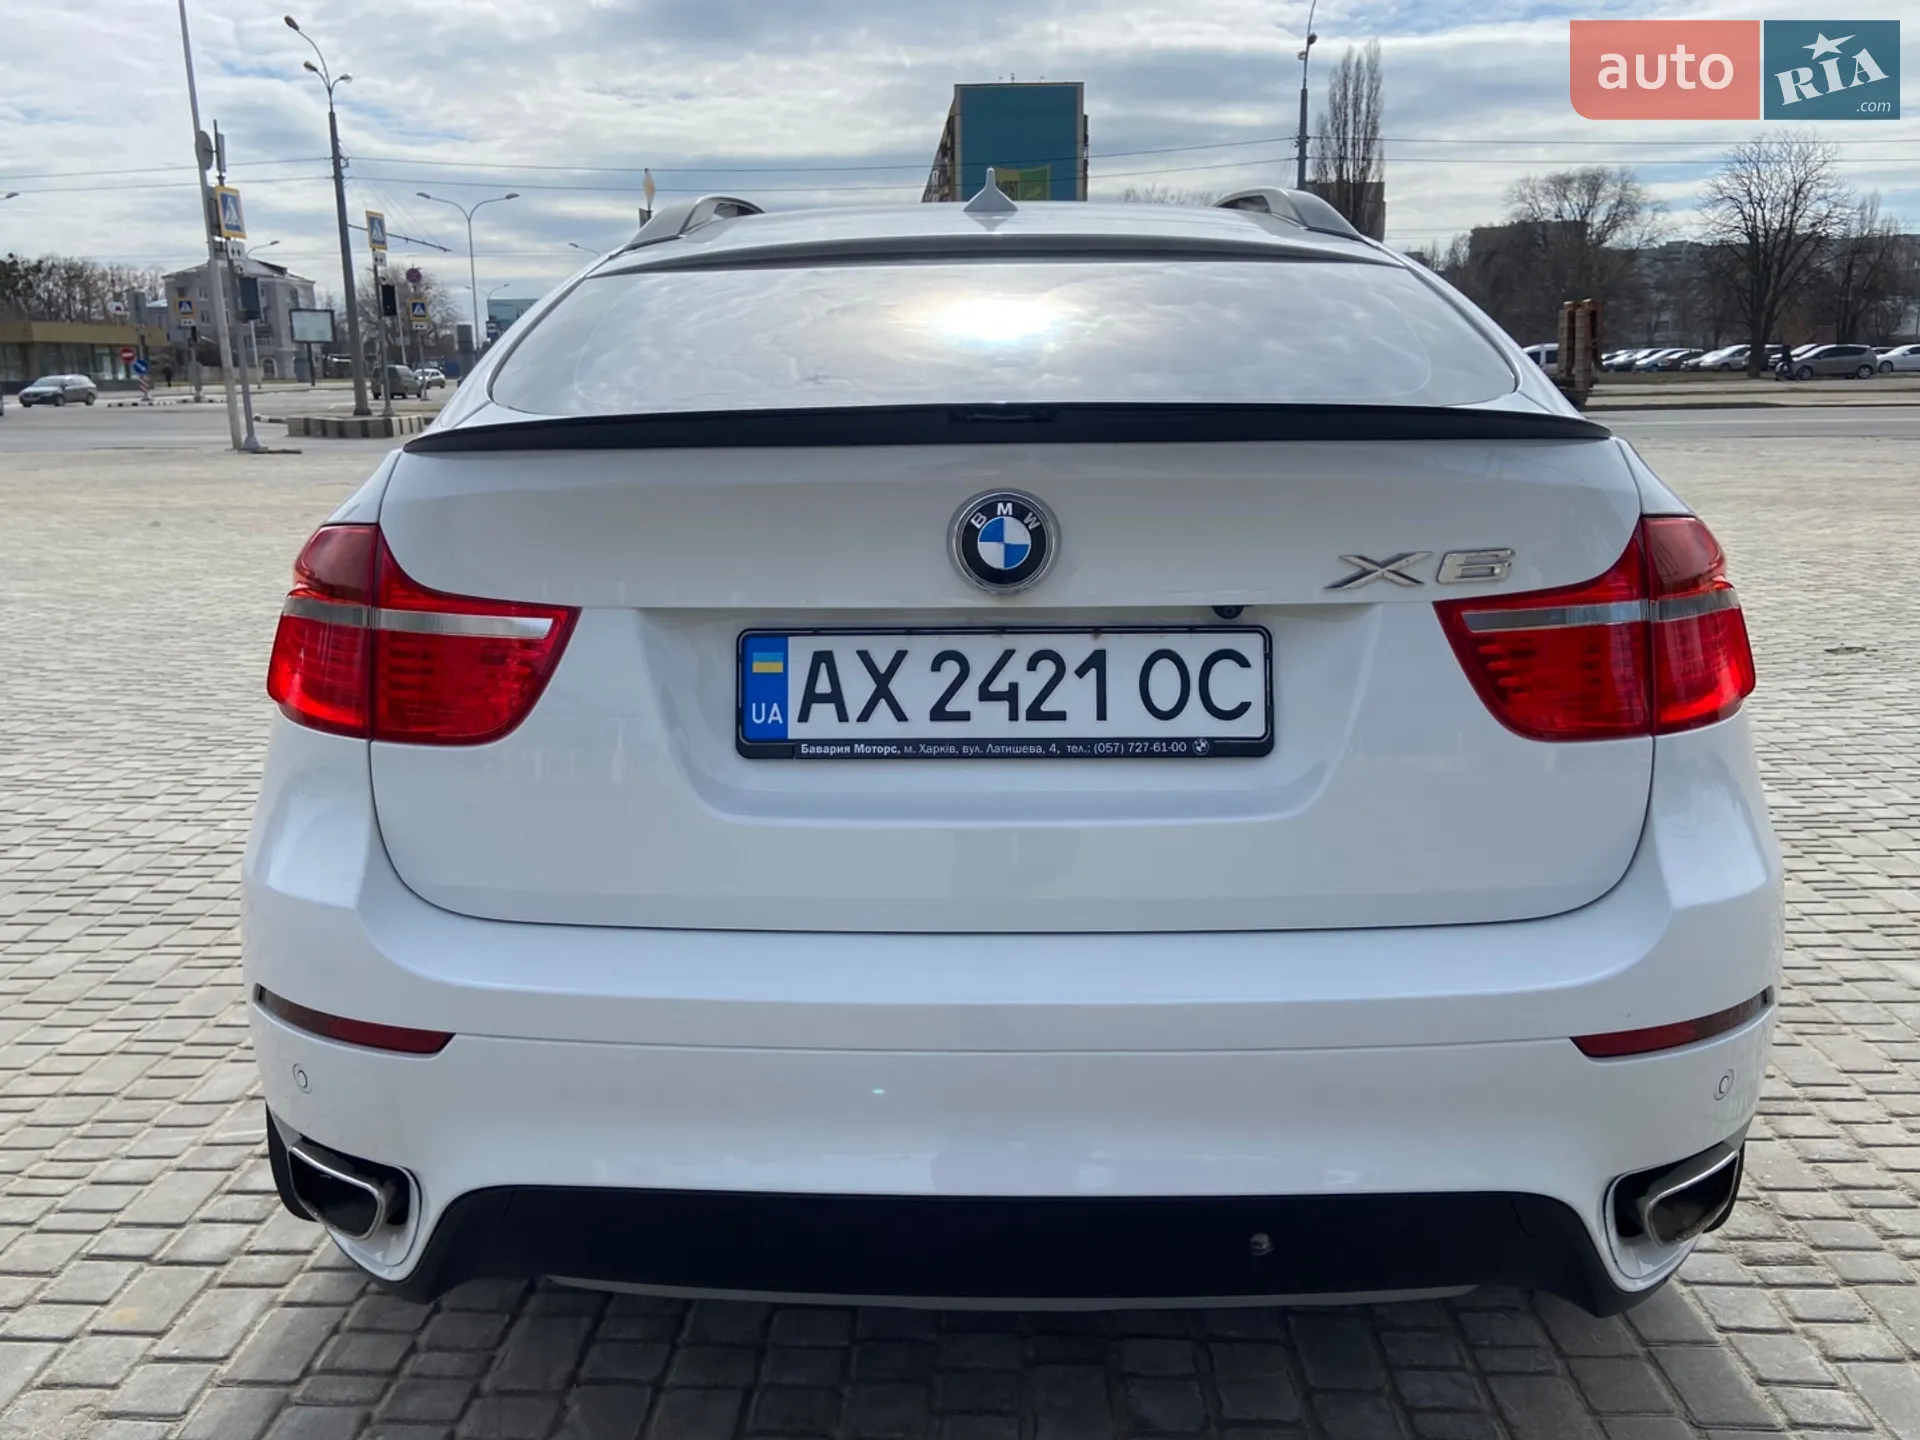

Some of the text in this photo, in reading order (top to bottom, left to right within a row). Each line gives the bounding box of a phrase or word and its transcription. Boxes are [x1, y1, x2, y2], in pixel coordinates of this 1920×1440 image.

[970, 502, 1041, 530] BMW
[1323, 548, 1516, 590] X6
[797, 648, 1252, 723] AX 2421 OC
[752, 702, 784, 724] UA
[801, 741, 1187, 756] Бавария Моторс, м. Харків, вул. Латишева, 4, тел.: (057) 727-61-00
